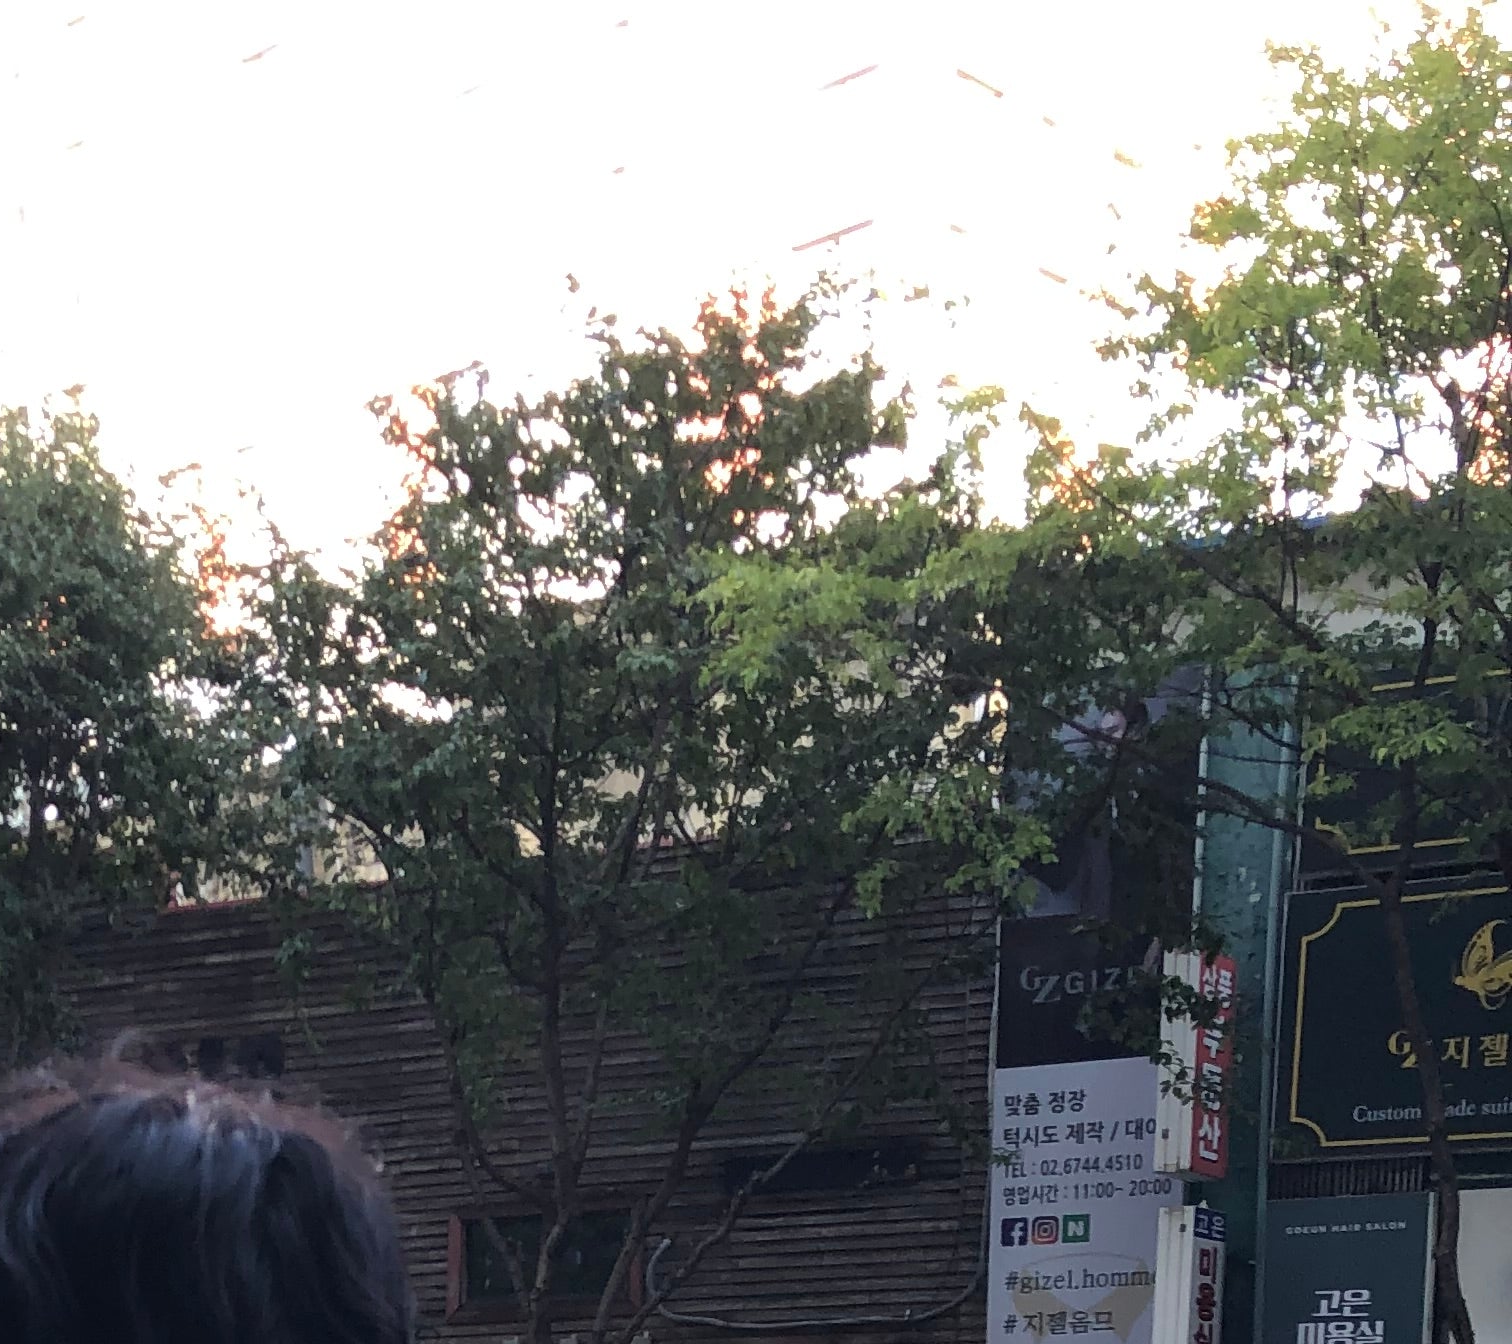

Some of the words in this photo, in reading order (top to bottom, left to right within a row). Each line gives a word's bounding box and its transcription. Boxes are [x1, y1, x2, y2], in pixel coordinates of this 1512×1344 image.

[1004, 1093, 1042, 1117] 맞춤
[1048, 1089, 1086, 1114] 정장
[1353, 1105, 1422, 1122] Custom
[1444, 1099, 1476, 1117] ade
[1003, 1125, 1060, 1149] 턱시도
[1065, 1121, 1104, 1144] 제작
[1003, 1184, 1059, 1206] 영업시간
[1311, 1289, 1372, 1317] 고은
